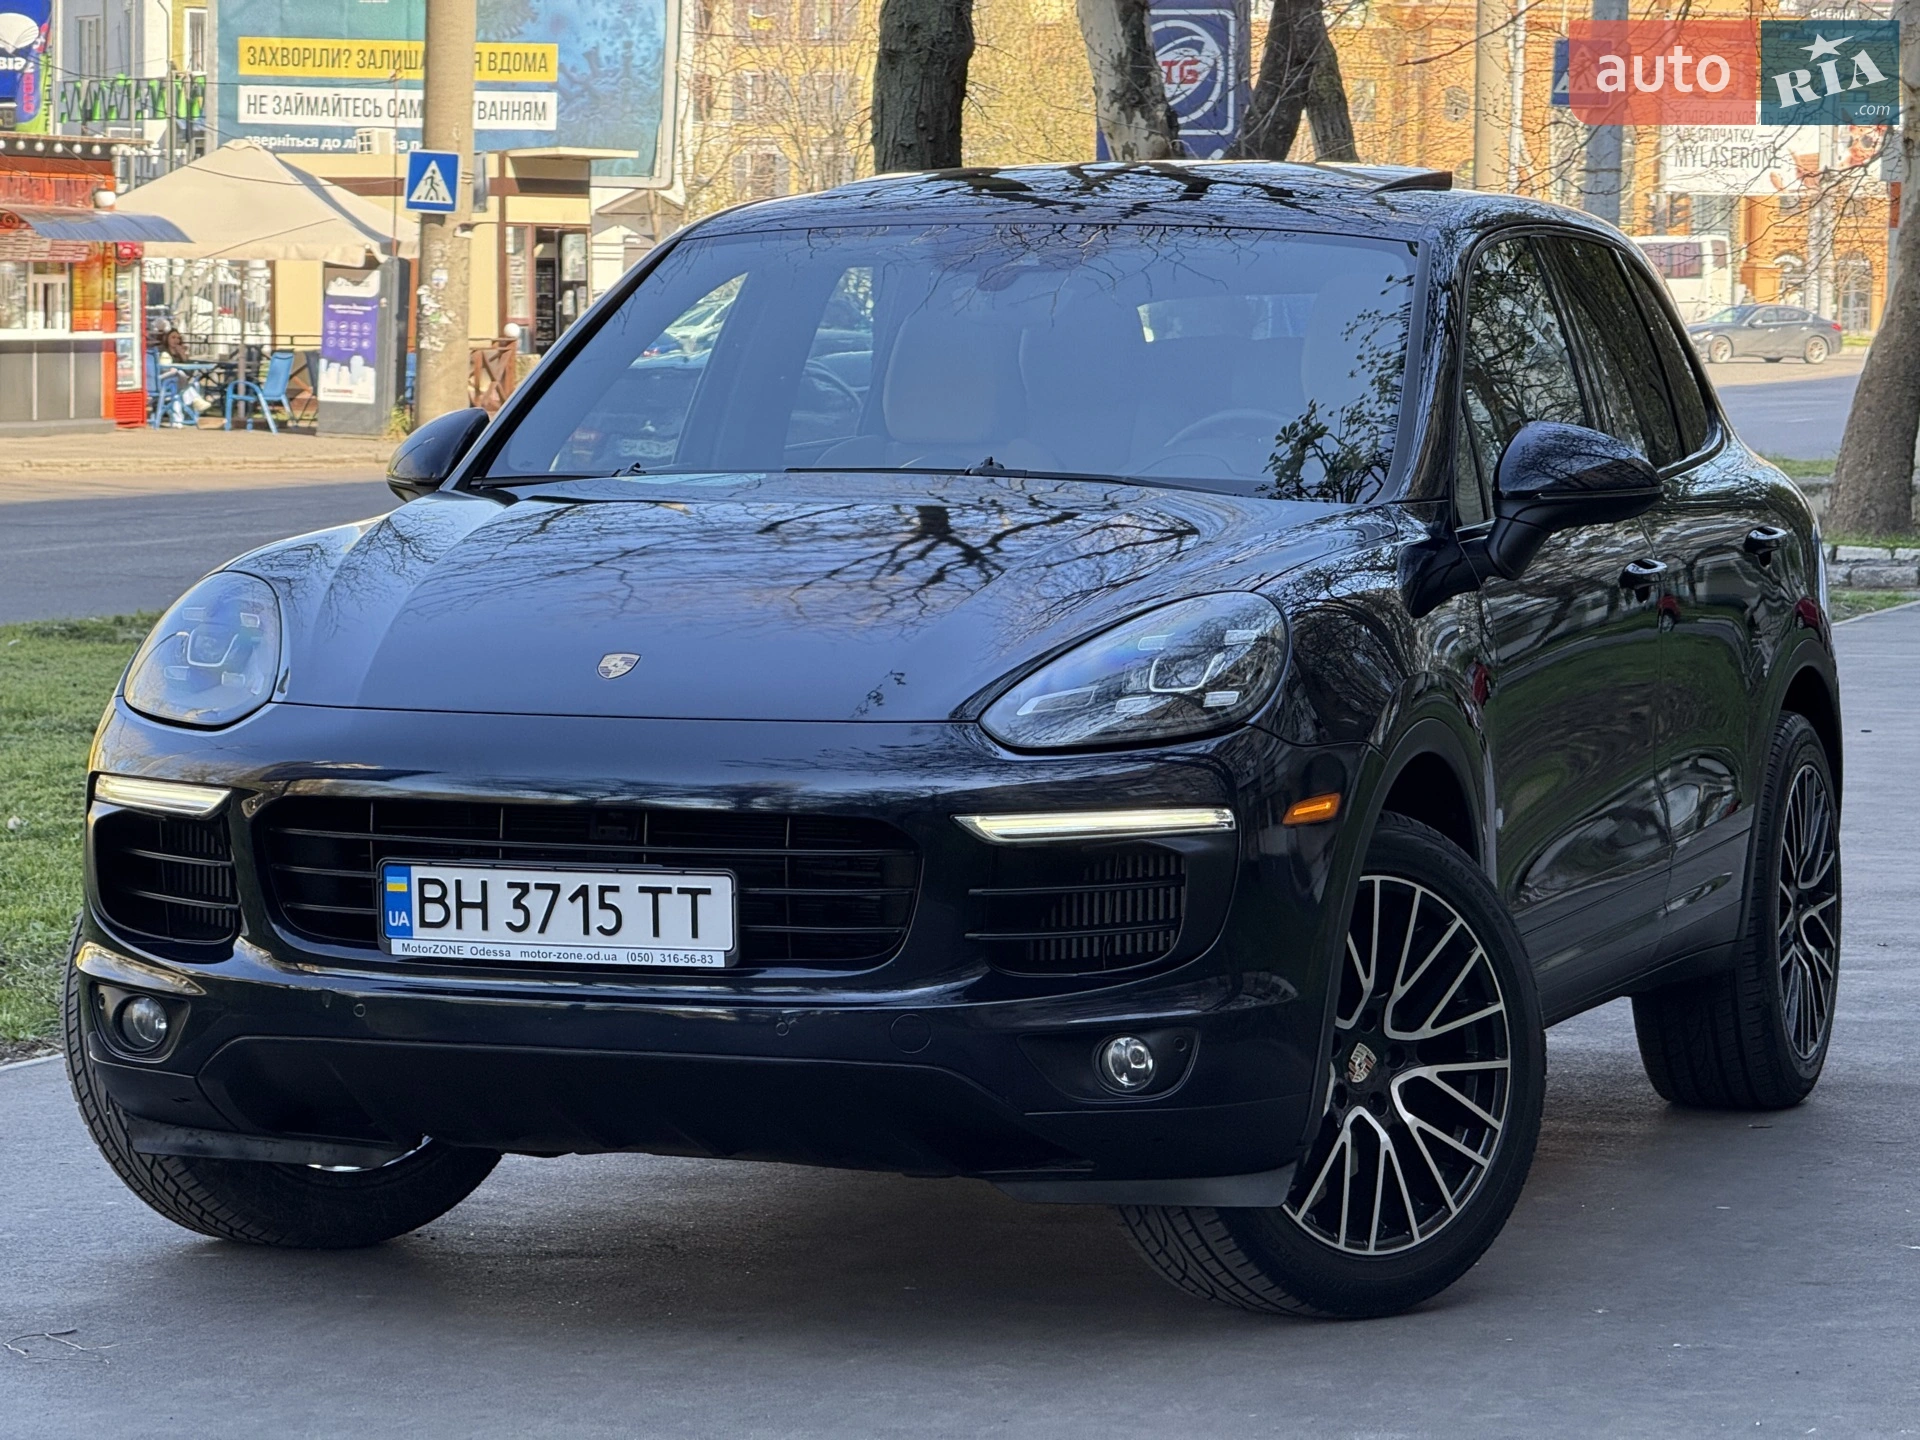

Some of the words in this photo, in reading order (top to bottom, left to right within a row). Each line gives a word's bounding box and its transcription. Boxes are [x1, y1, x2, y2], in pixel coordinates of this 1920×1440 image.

[247, 46, 352, 69] ЗАХВОРІЛИ?
[488, 52, 548, 74] ВДОМА
[247, 94, 268, 115] НЕ
[272, 92, 382, 118] ЗАЙМАЙТЕСЬ
[320, 138, 341, 150] до
[388, 910, 410, 928] UA
[417, 877, 489, 931] BH
[505, 881, 623, 937] 3715
[637, 885, 712, 939] TT
[401, 943, 464, 956] MotorZONE
[470, 946, 511, 958] Odessa
[520, 949, 618, 963] motor-zone.od.ua
[626, 951, 654, 964] (050)
[660, 953, 714, 965] 316-56-83
